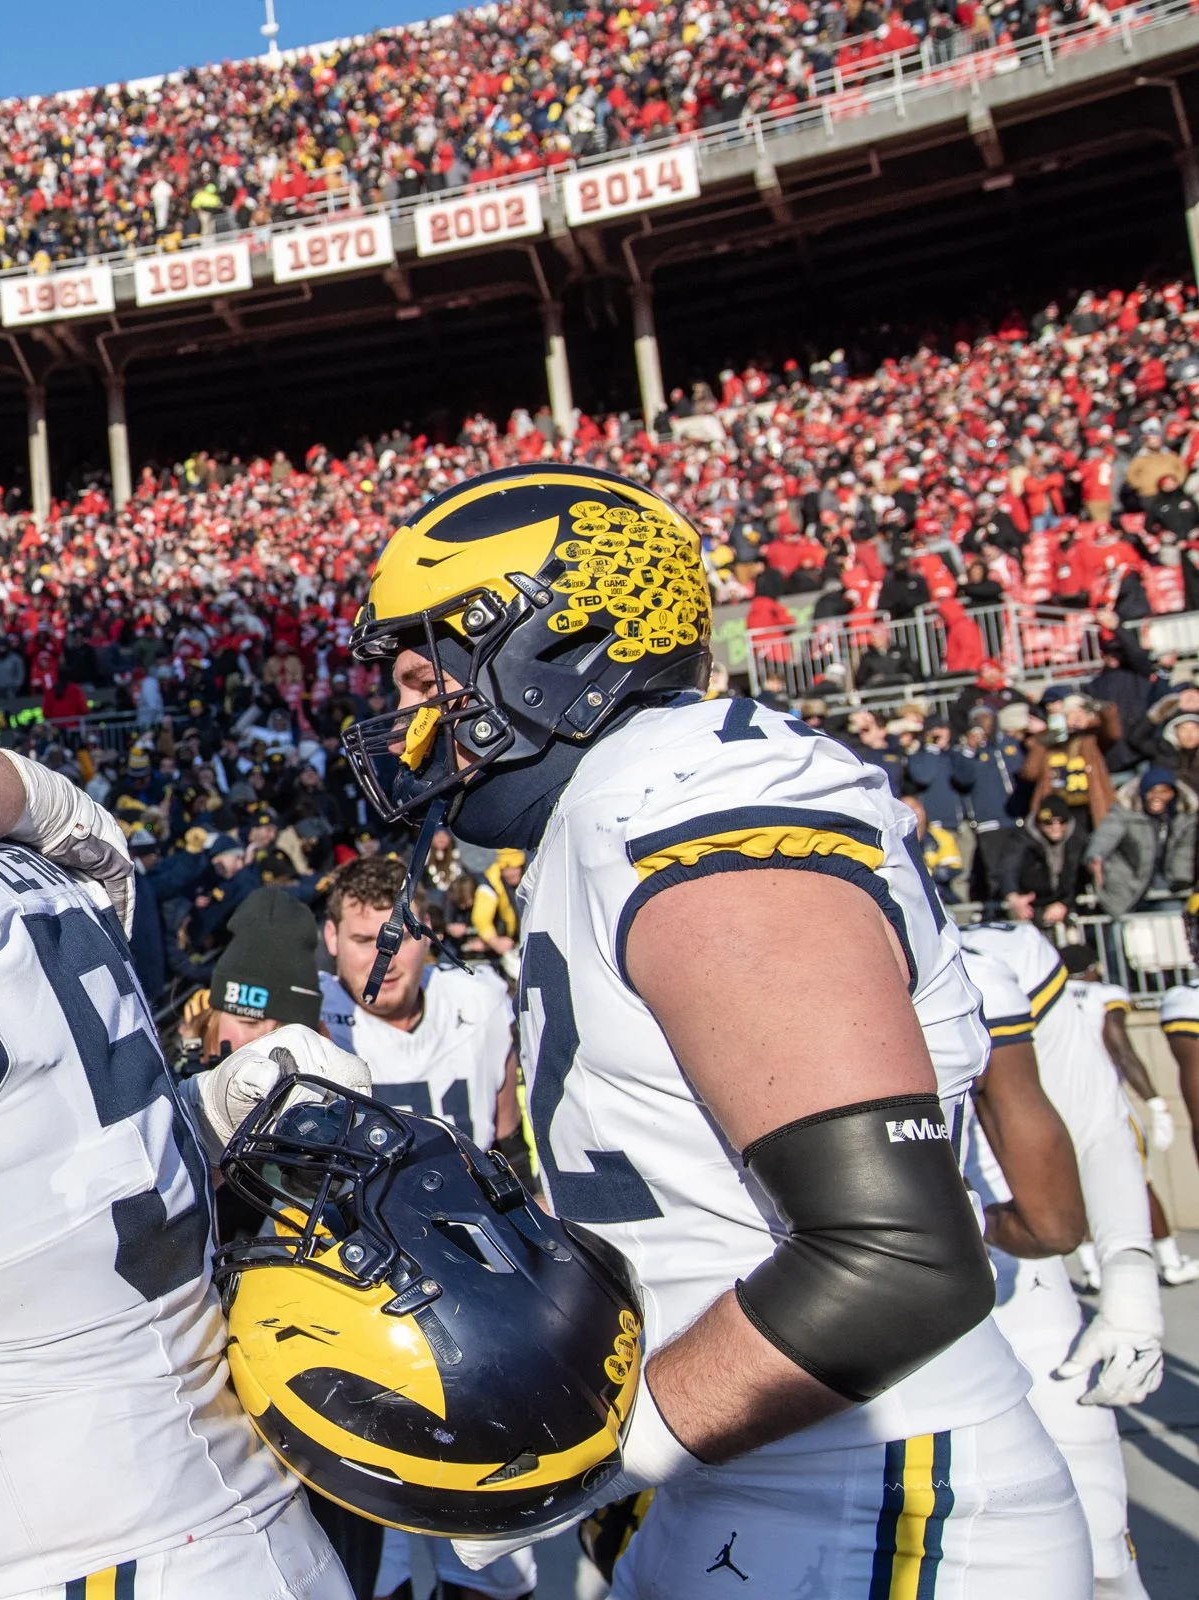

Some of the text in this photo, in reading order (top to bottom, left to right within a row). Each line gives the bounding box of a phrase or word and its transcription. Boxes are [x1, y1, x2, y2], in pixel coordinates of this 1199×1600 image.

[578, 157, 684, 213] 2014
[429, 196, 527, 244] 2002
[287, 226, 376, 271] 1970
[148, 253, 237, 296] 1968
[16, 276, 99, 317] 1961
[628, 525, 649, 535] GAME
[575, 595, 603, 608] TED
[603, 580, 628, 588] GAME
[649, 637, 672, 648] TED
